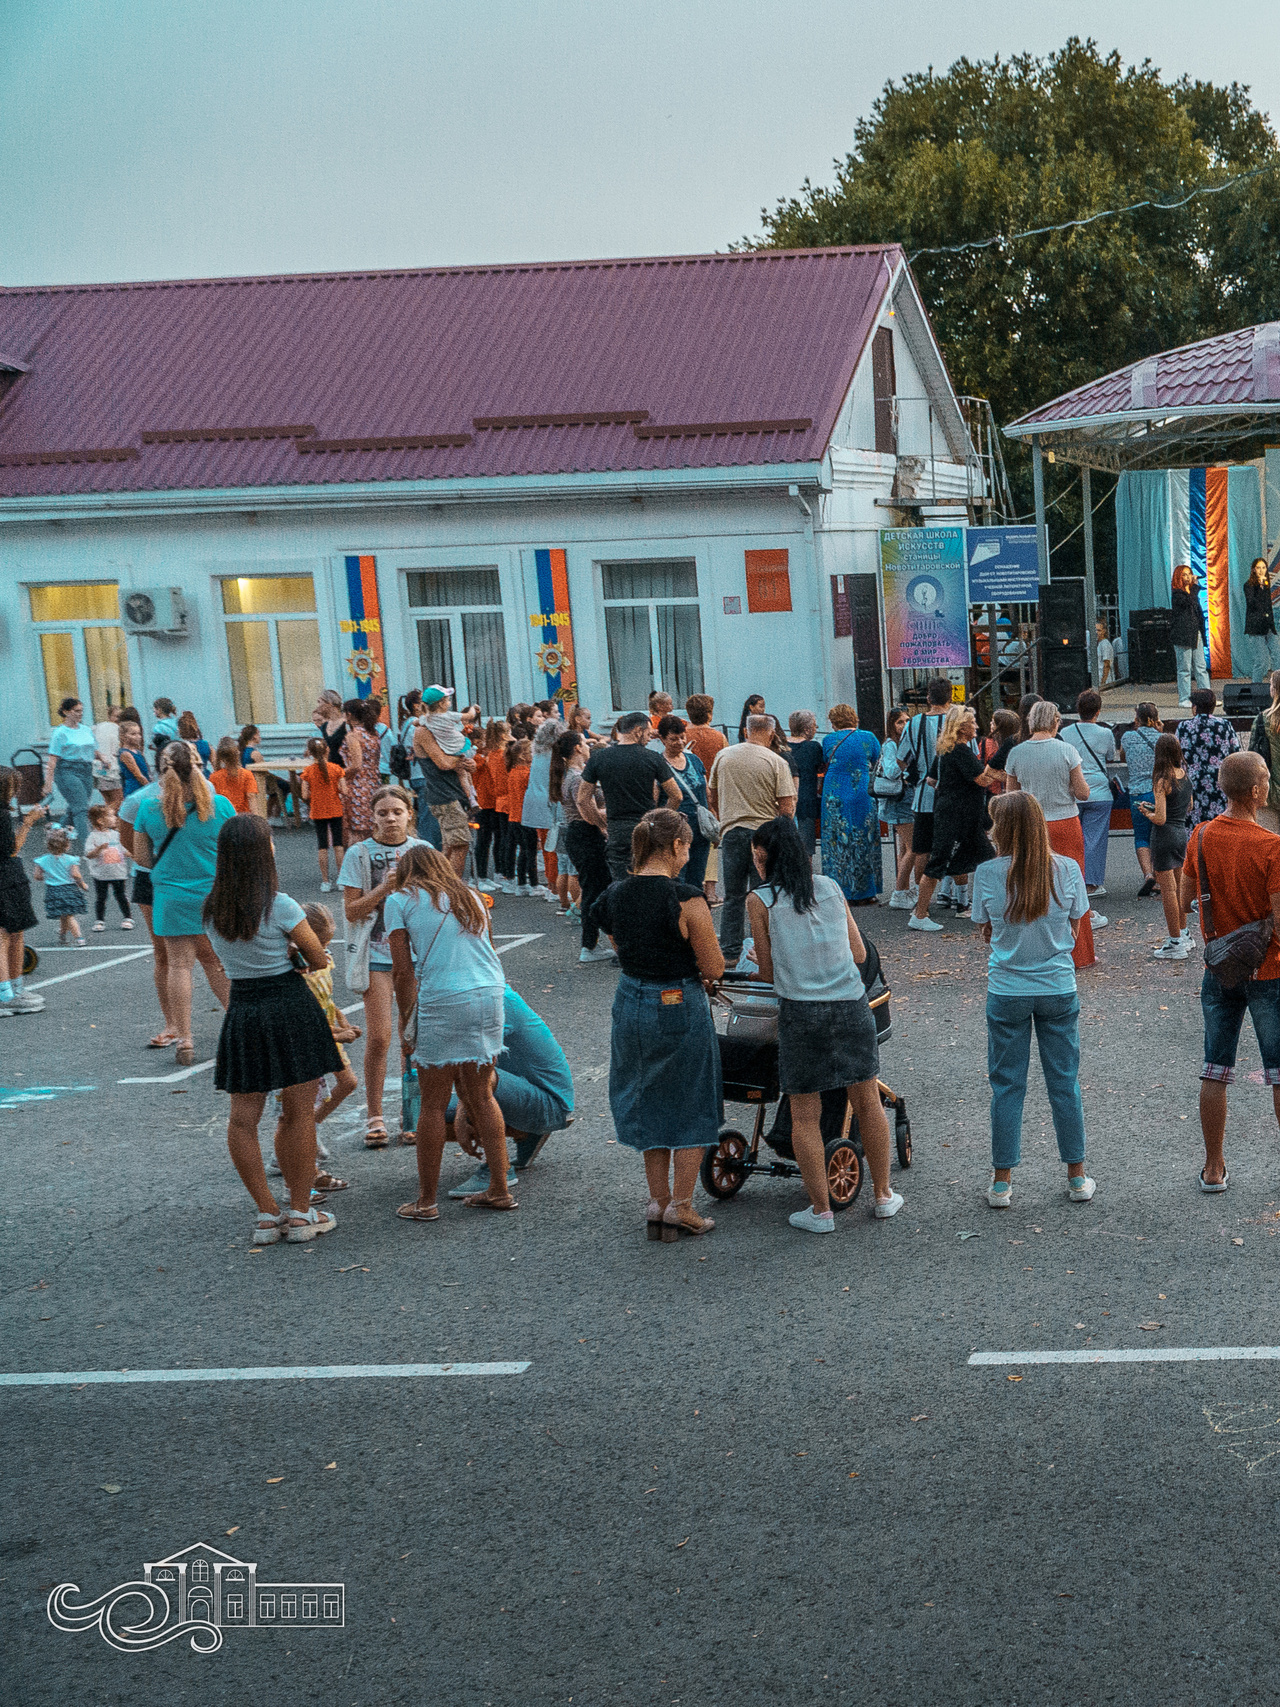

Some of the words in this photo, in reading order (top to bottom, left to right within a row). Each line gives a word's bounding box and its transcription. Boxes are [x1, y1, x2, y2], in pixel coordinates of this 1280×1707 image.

[884, 532, 924, 541] ДЕТСКАЯ
[926, 531, 959, 539] ШКОЛА
[898, 542, 945, 551] ИСКУССТВ
[903, 553, 941, 561] станицы
[885, 562, 961, 572] Новотитаровской
[528, 612, 570, 627] 1941-1945
[339, 618, 380, 633] 1941-1945
